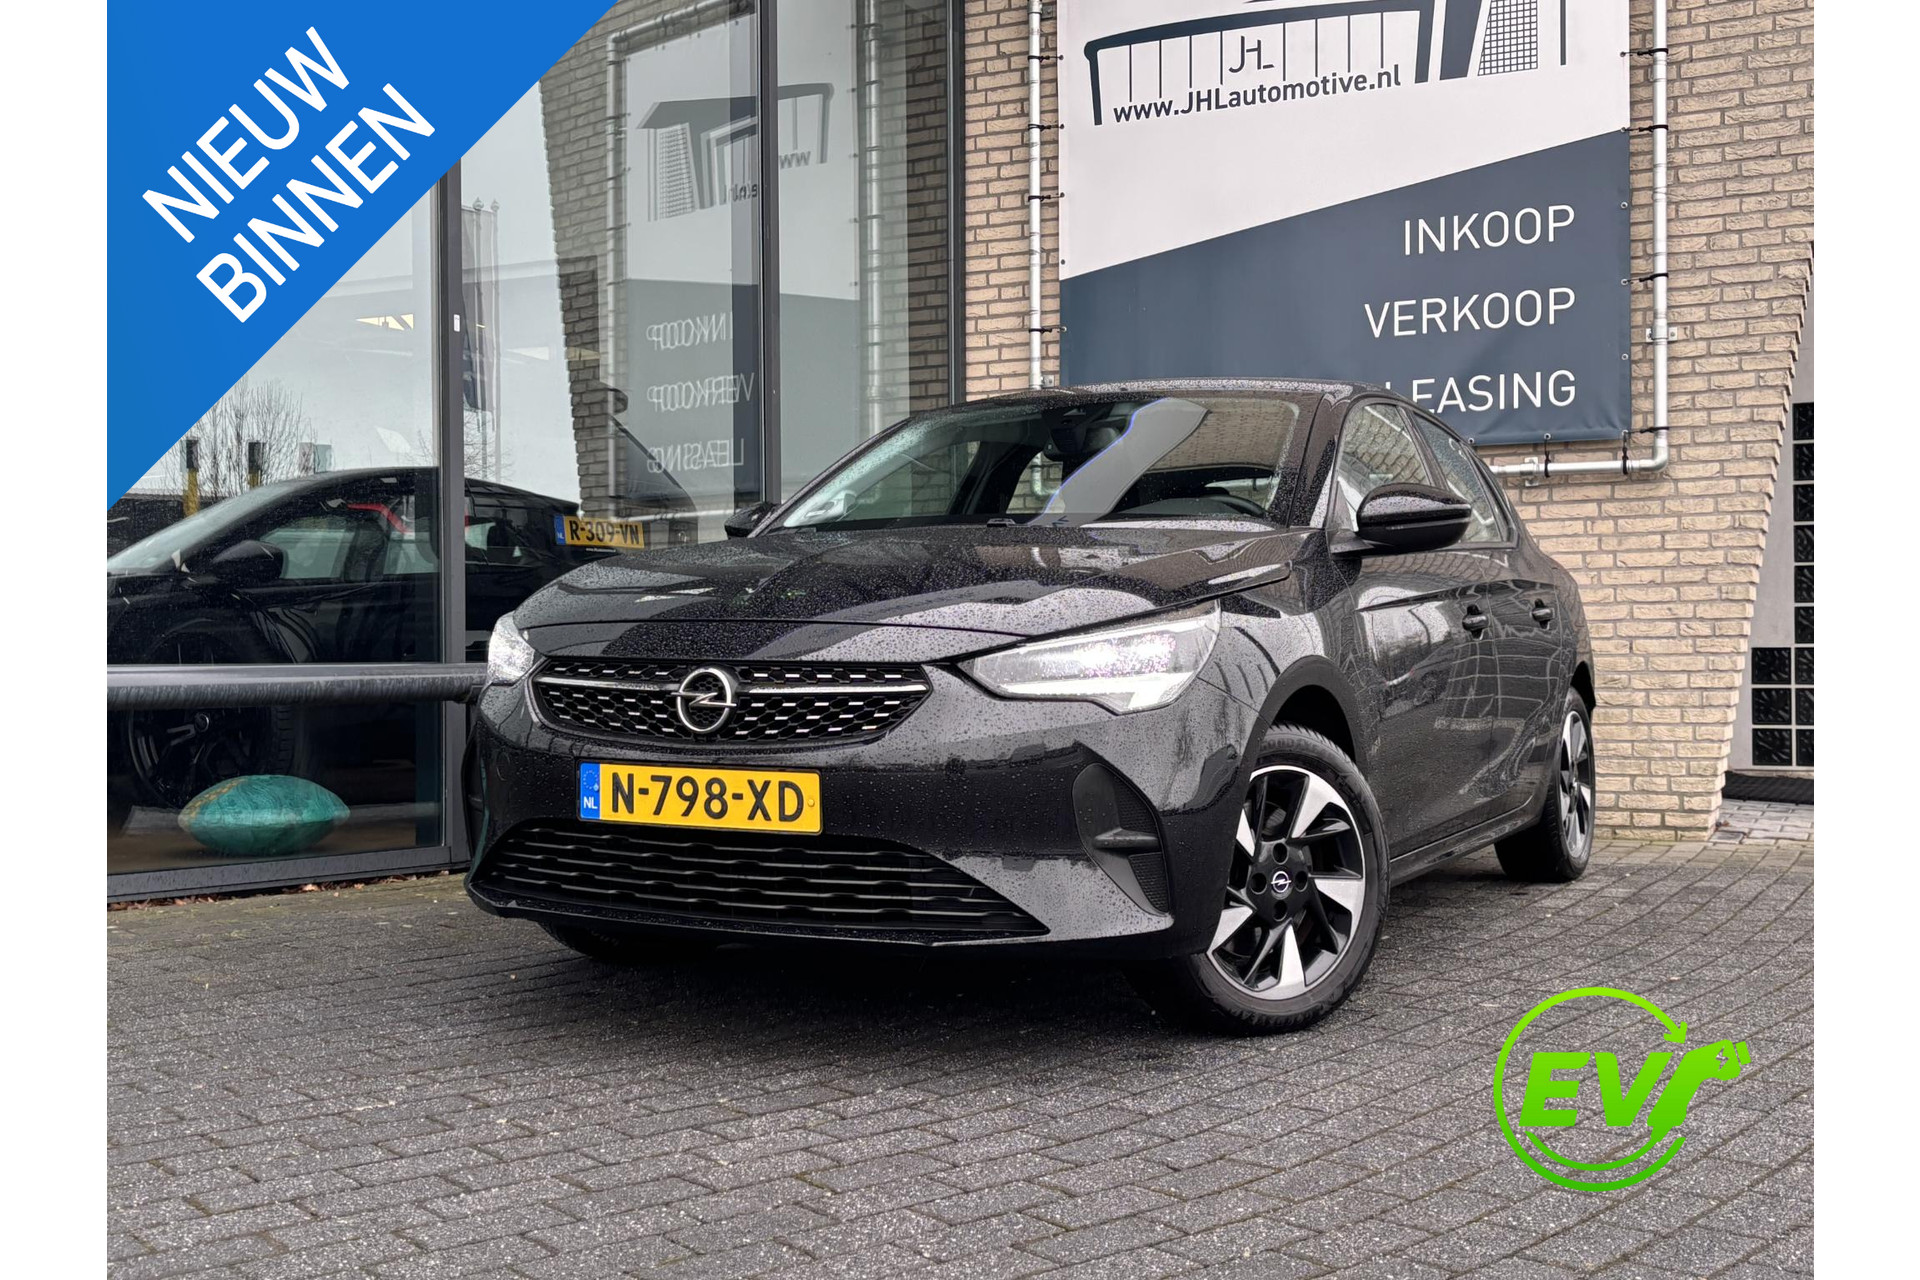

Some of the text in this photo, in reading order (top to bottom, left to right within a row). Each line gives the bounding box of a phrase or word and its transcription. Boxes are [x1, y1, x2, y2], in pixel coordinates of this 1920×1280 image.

[1113, 64, 1401, 123] www.JHLautomotive.nl
[1404, 204, 1575, 256] INKOOP
[1364, 287, 1576, 338] VERKOOP
[1385, 369, 1577, 415] EASING
[569, 520, 640, 545] R-309-VN
[583, 796, 598, 810] NL
[611, 771, 804, 823] N-798-XD
